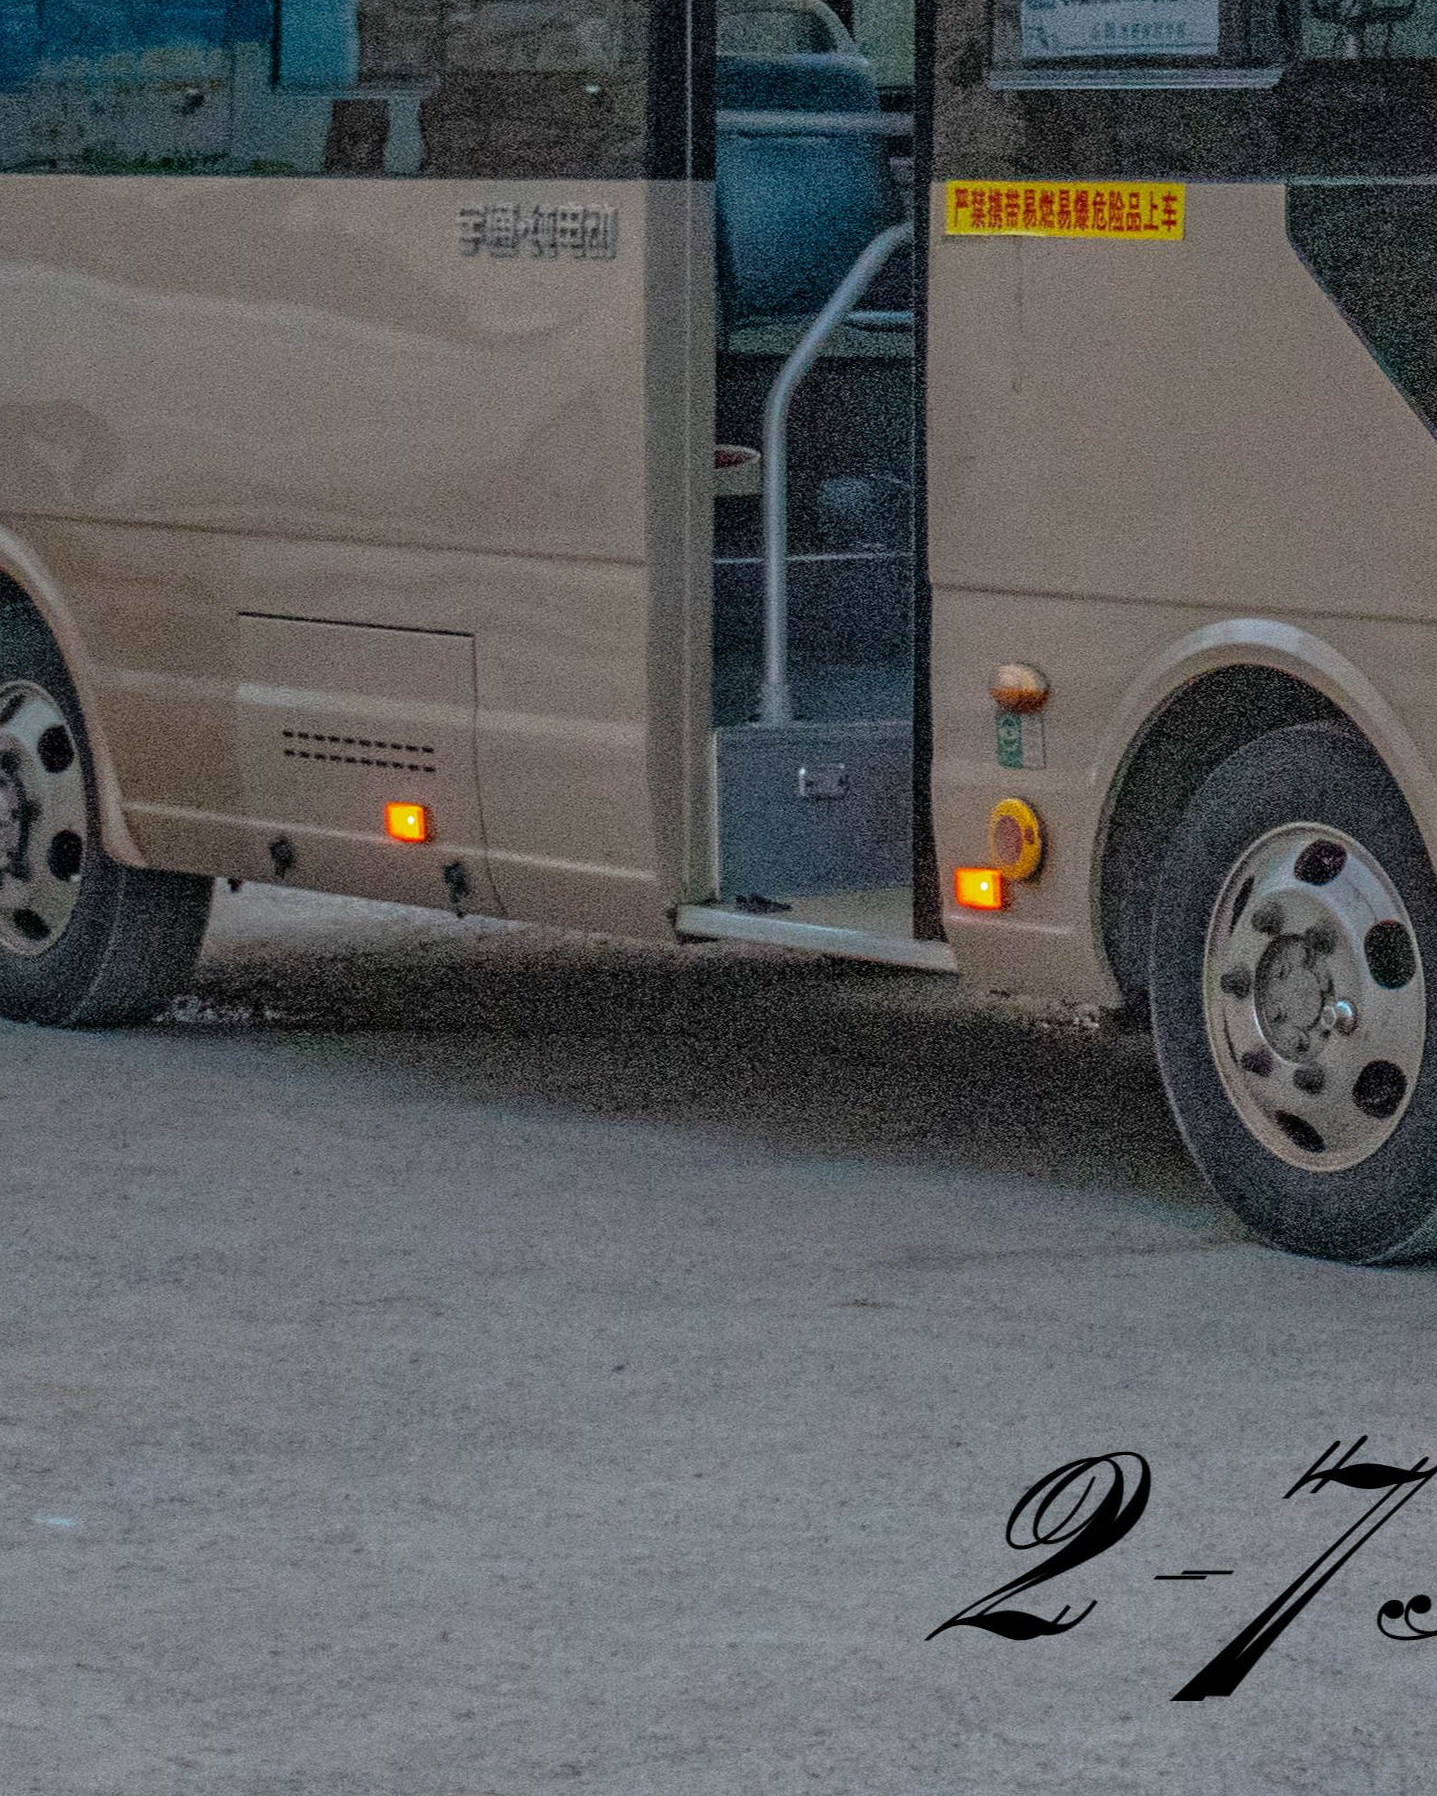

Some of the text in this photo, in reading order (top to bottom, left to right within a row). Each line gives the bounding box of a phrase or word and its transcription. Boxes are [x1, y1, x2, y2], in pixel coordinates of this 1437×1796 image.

[953, 188, 1178, 234] 严禁携带易燃易爆危险品上车
